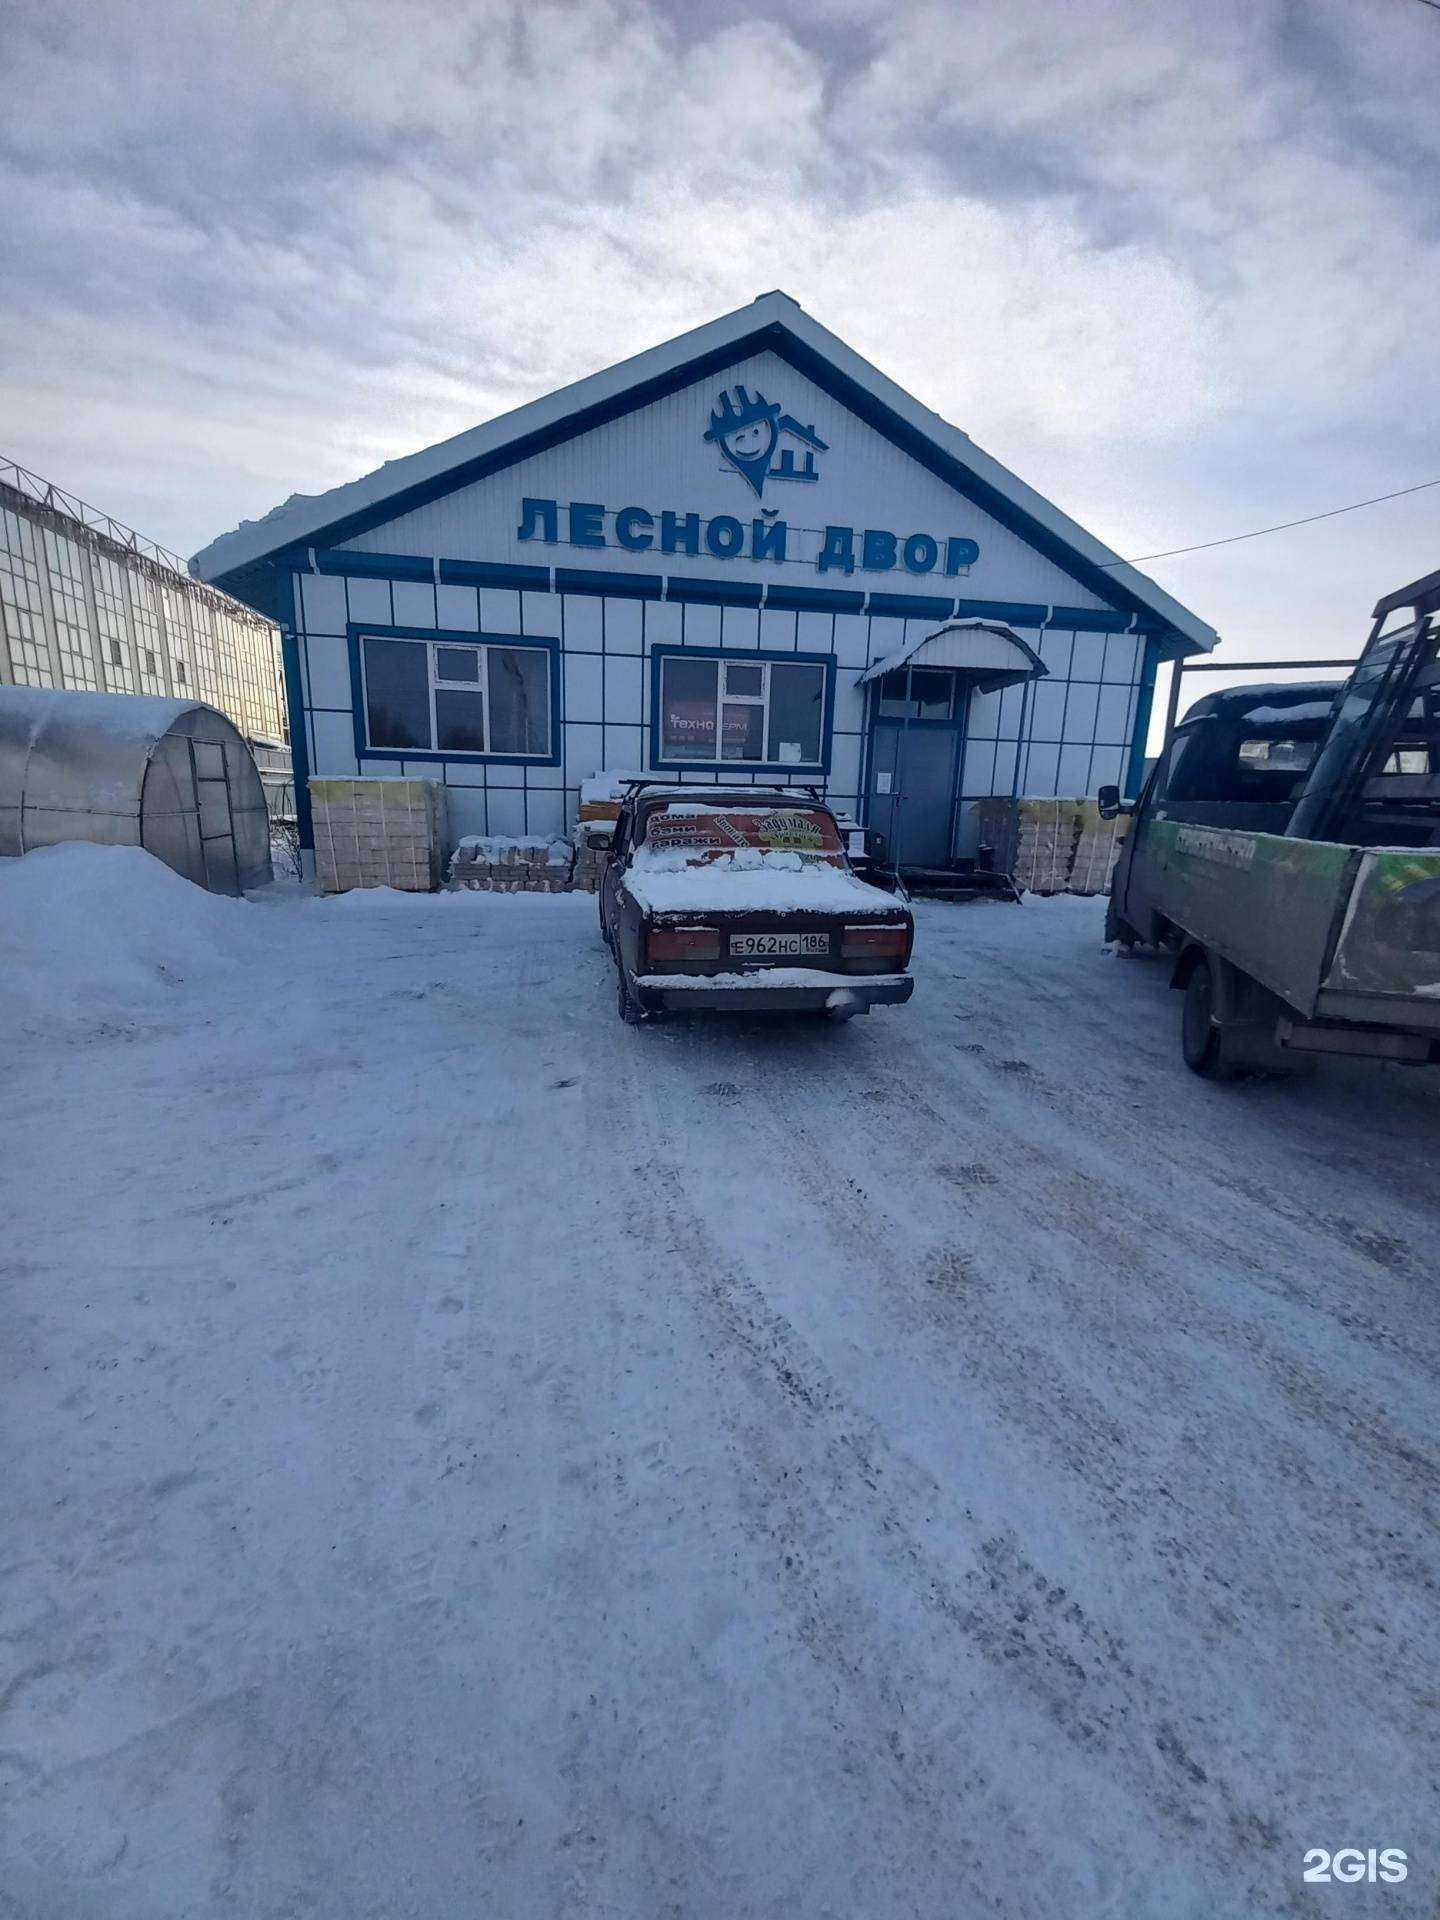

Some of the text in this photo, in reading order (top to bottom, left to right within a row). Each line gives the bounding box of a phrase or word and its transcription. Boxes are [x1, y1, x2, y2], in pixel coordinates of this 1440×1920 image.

[518, 498, 980, 576] ЛЕСНОЙ ДВОР
[802, 935, 826, 947] 186
